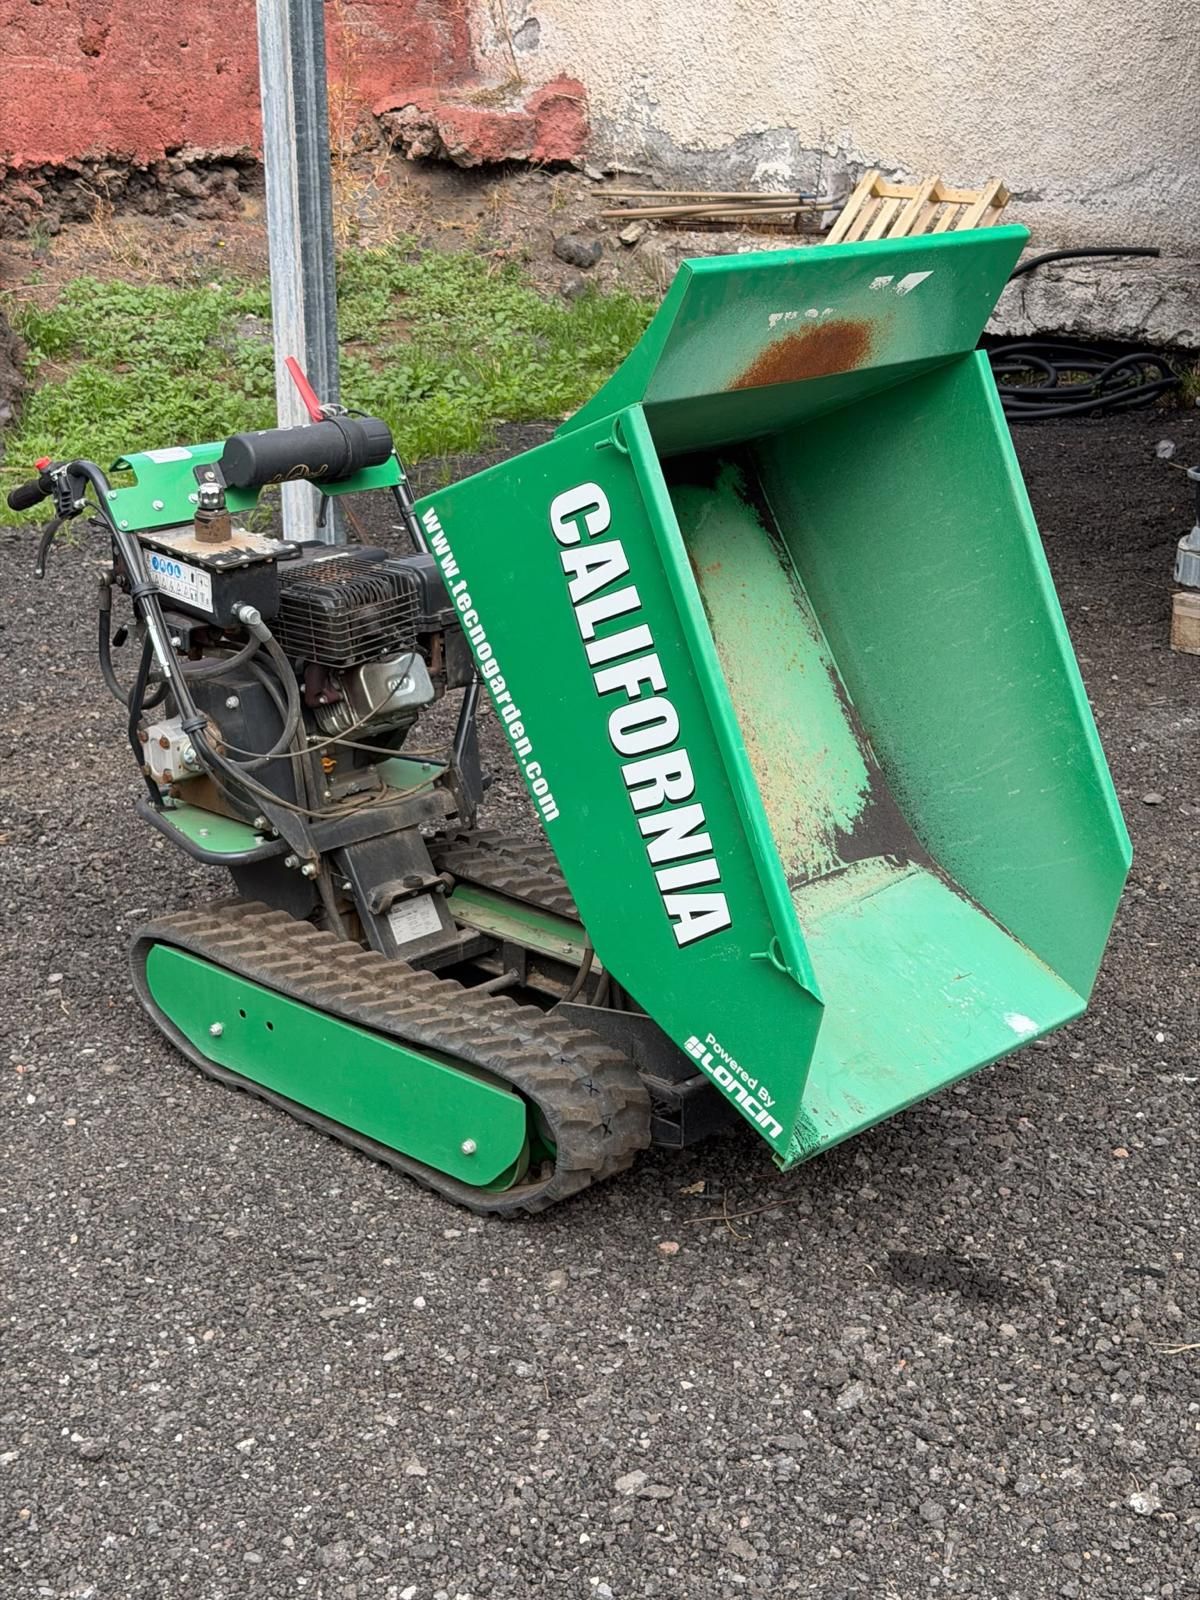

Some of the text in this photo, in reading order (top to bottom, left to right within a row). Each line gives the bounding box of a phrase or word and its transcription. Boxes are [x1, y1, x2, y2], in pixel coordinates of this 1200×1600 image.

[420, 507, 560, 822] www.tecnogarden.com
[549, 481, 732, 947] CALIFORNIA
[705, 1032, 776, 1108] Powered By
